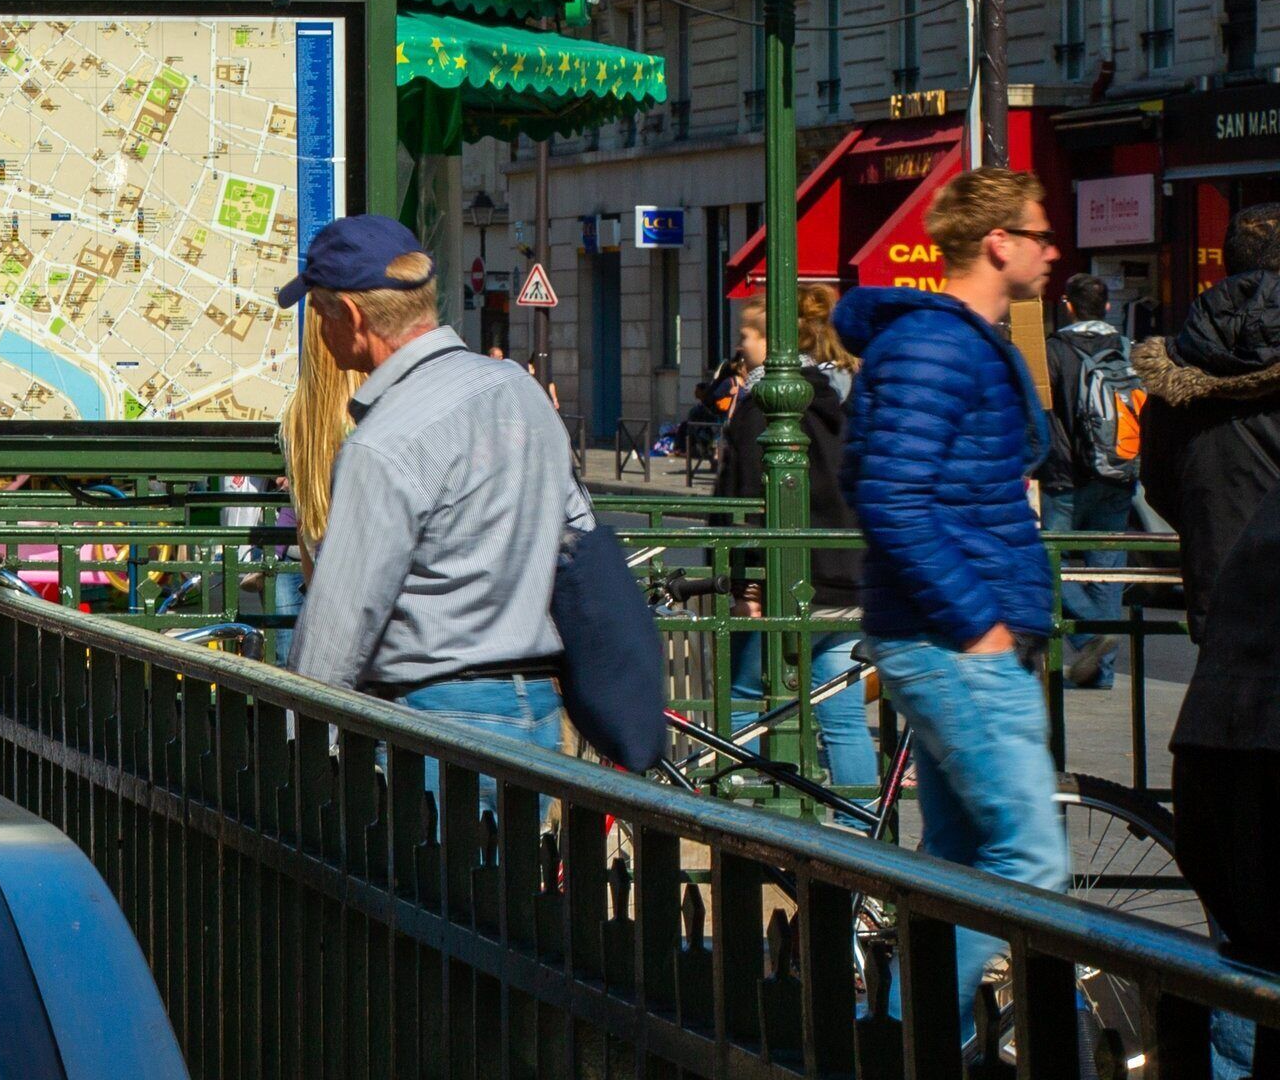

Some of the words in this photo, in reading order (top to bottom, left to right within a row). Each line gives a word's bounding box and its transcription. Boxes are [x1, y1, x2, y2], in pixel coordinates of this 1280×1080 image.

[1216, 112, 1245, 139] SAN
[643, 216, 677, 229] LCL
[889, 244, 945, 263] CAF
